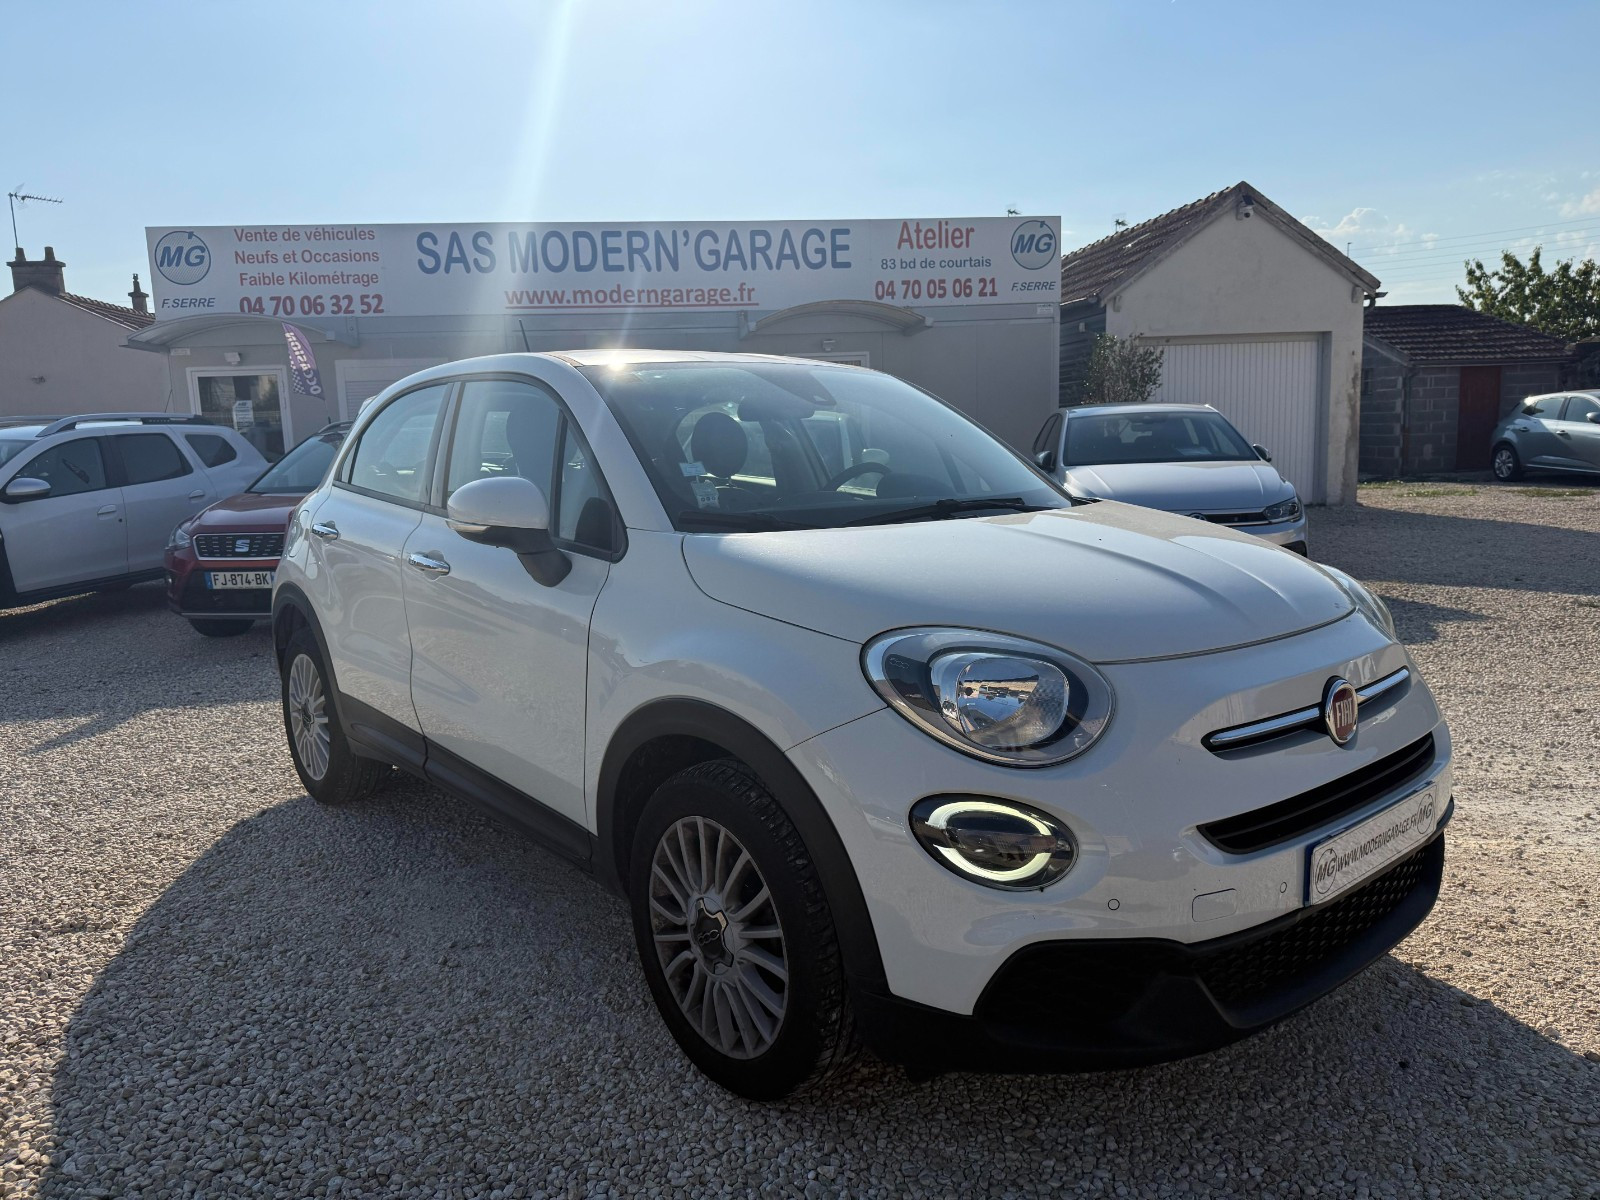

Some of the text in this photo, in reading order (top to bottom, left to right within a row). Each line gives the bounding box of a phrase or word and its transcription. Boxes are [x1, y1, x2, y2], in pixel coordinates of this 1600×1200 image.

[234, 227, 376, 242] Vente de véhicules
[897, 220, 975, 250] Atelier
[1013, 233, 1053, 254] MG
[159, 245, 205, 268] MG
[235, 249, 380, 264] Neufs et Occasions
[416, 231, 497, 275] SAS
[880, 256, 992, 270] 83 bd de courtais
[239, 271, 379, 287] Faible Kilométrage
[875, 277, 998, 300] 04 70 05 06 21
[1011, 281, 1056, 291] F.SERRE
[161, 297, 216, 309] F.SERRE
[239, 293, 385, 316] 04 70 06 32 52
[504, 282, 756, 306] www.moderngarage.fr
[1335, 697, 1353, 729] FIAT
[1316, 857, 1336, 883] MG
